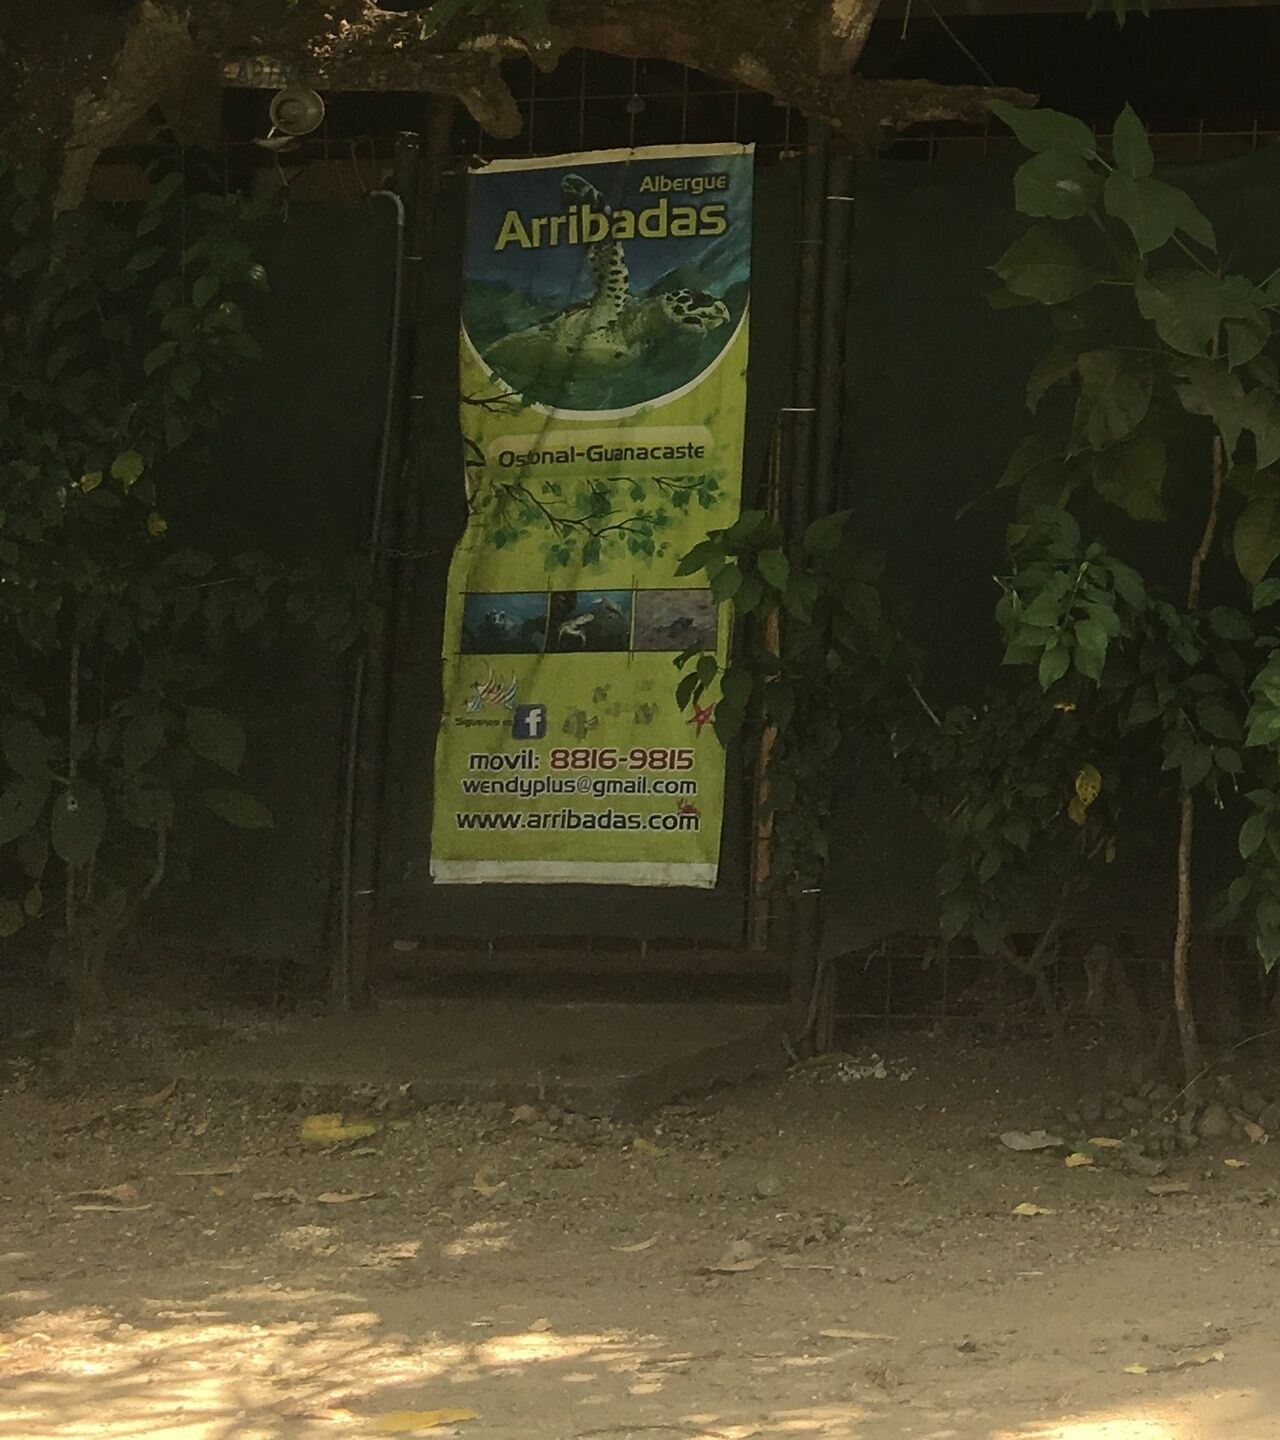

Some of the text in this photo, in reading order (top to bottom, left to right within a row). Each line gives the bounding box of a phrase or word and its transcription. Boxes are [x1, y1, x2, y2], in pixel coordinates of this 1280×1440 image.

[639, 175, 727, 194] Albergue
[494, 198, 727, 251] Arribadas
[469, 749, 695, 770] movil: 8816-9815
[462, 776, 697, 797] wendyplus@gmail.com
[456, 809, 700, 831] www.arribadas.com
